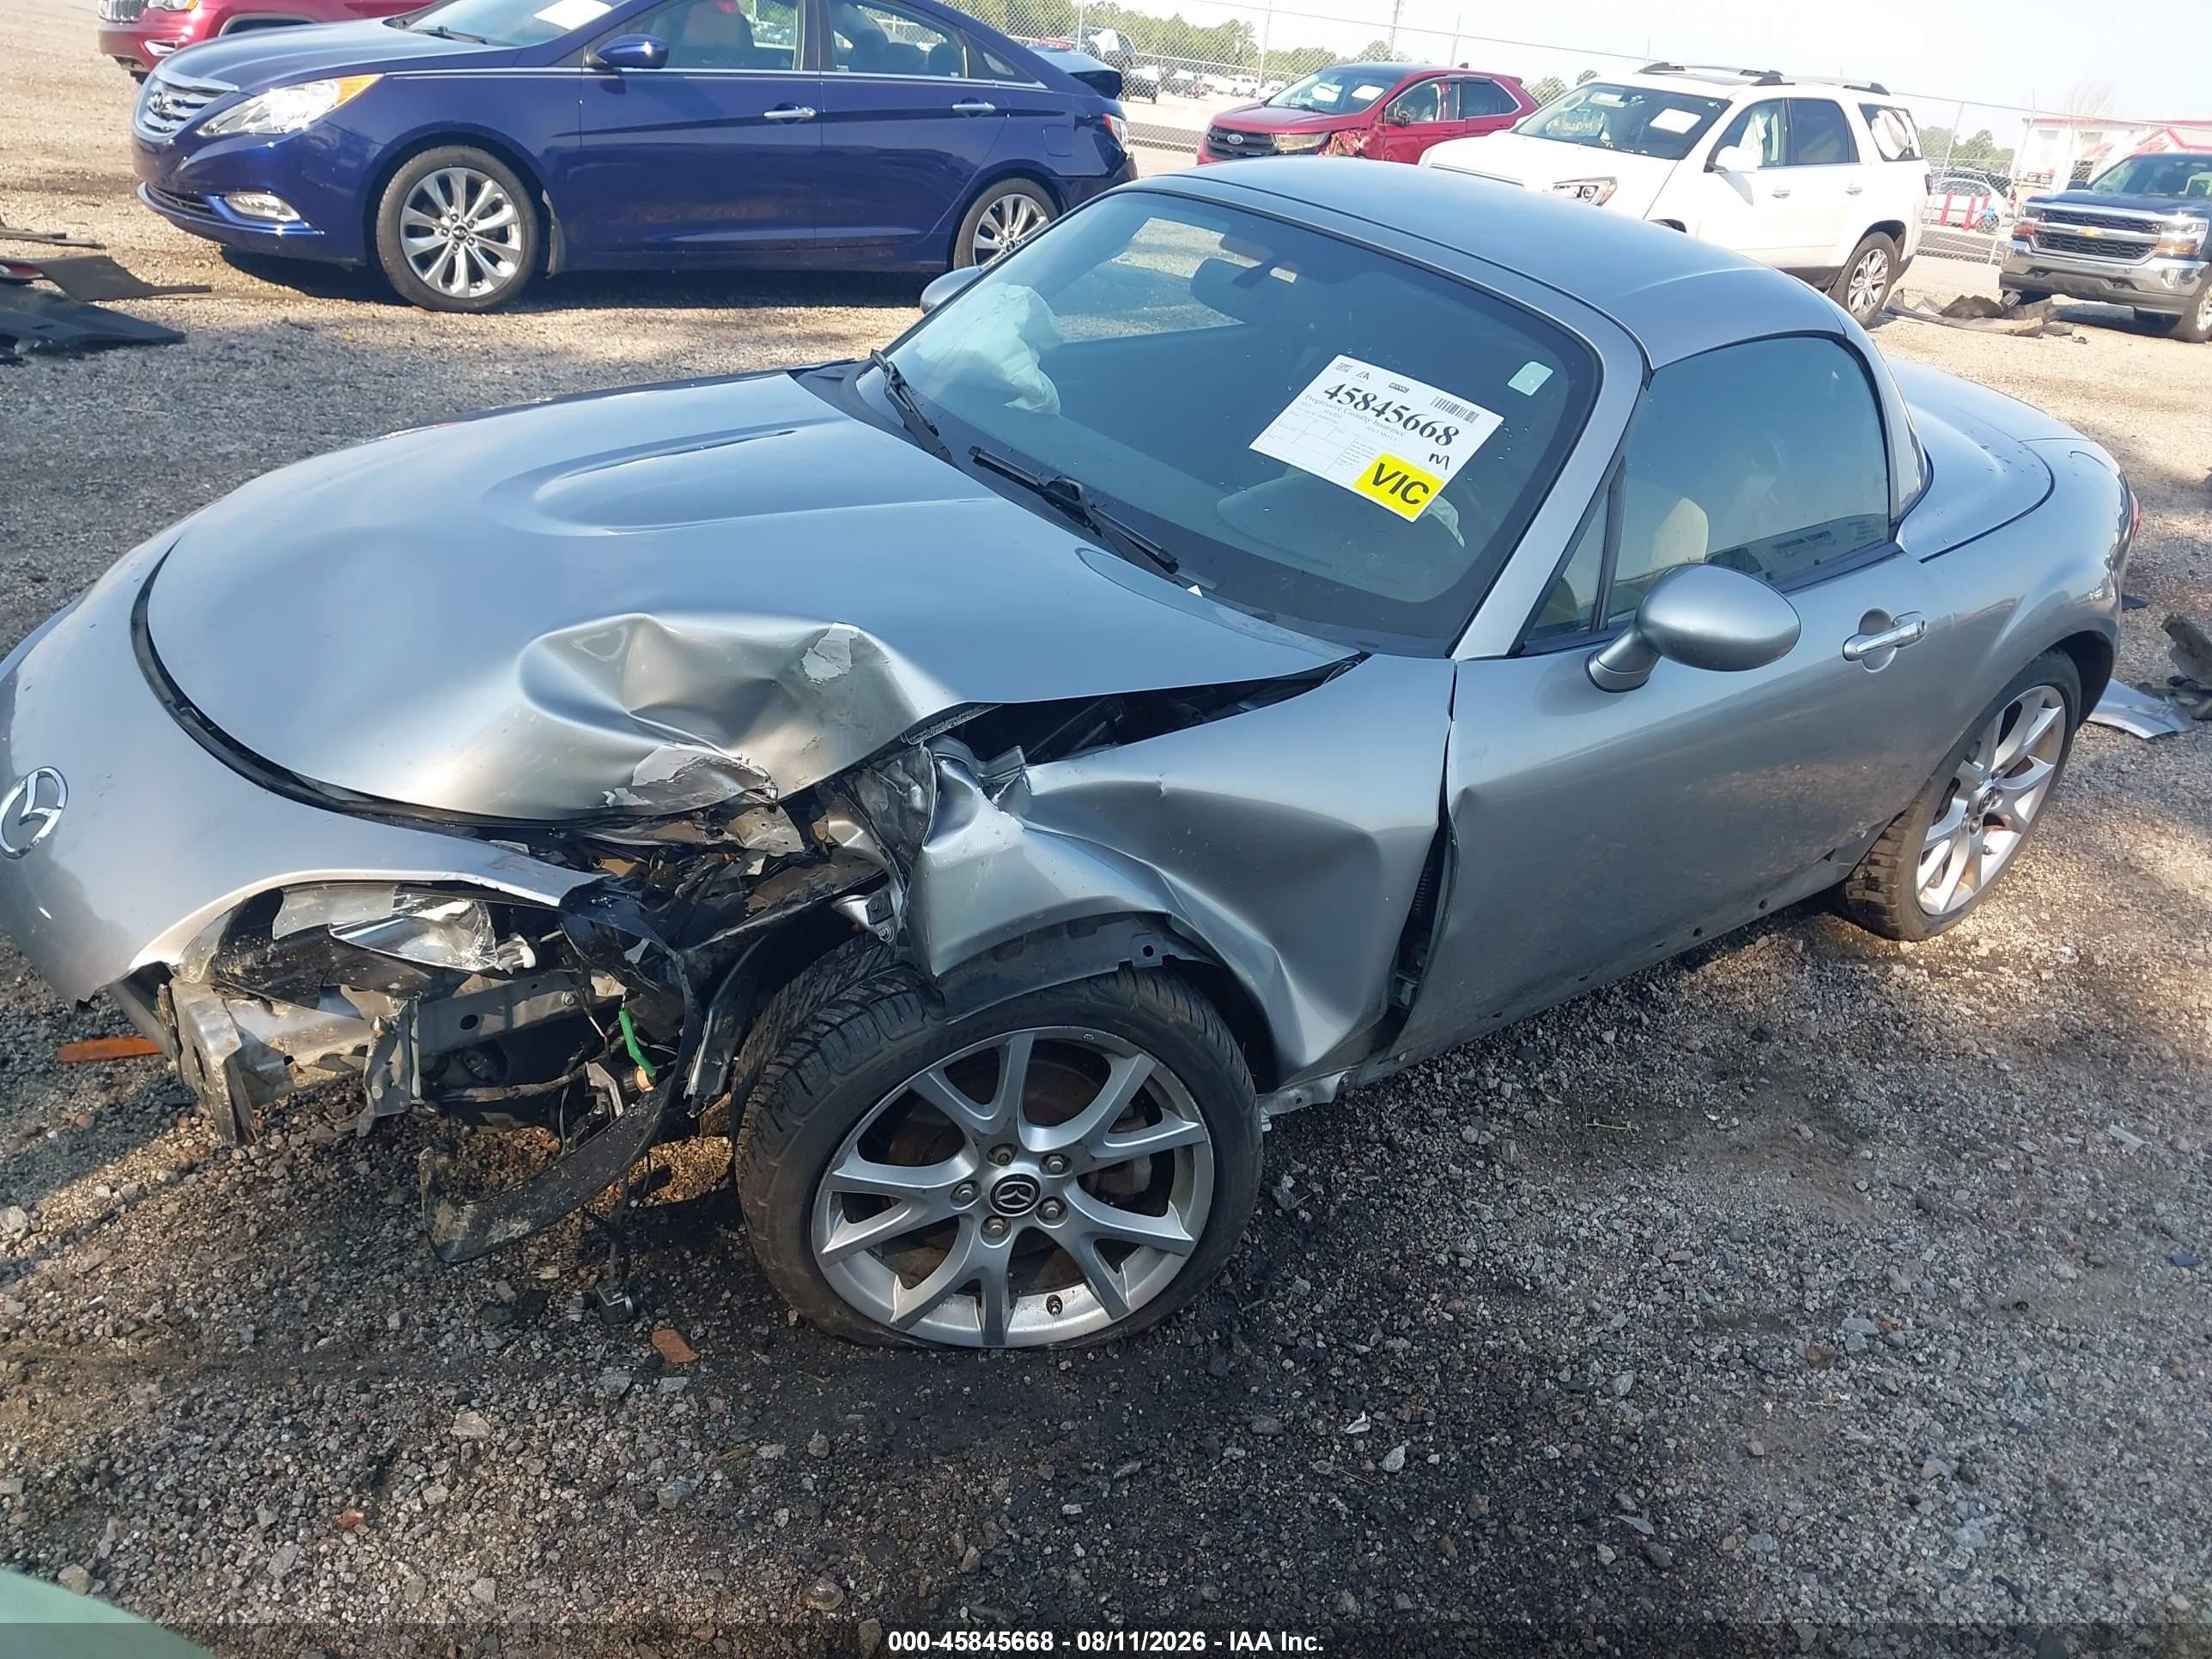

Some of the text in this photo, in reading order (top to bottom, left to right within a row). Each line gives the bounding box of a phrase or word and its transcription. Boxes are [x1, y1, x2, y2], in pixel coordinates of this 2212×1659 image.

[1323, 383, 1460, 447] 45845668
[1343, 407, 1372, 424] Casualty
[1373, 418, 1407, 437] Insurance
[1372, 462, 1430, 505] VIC
